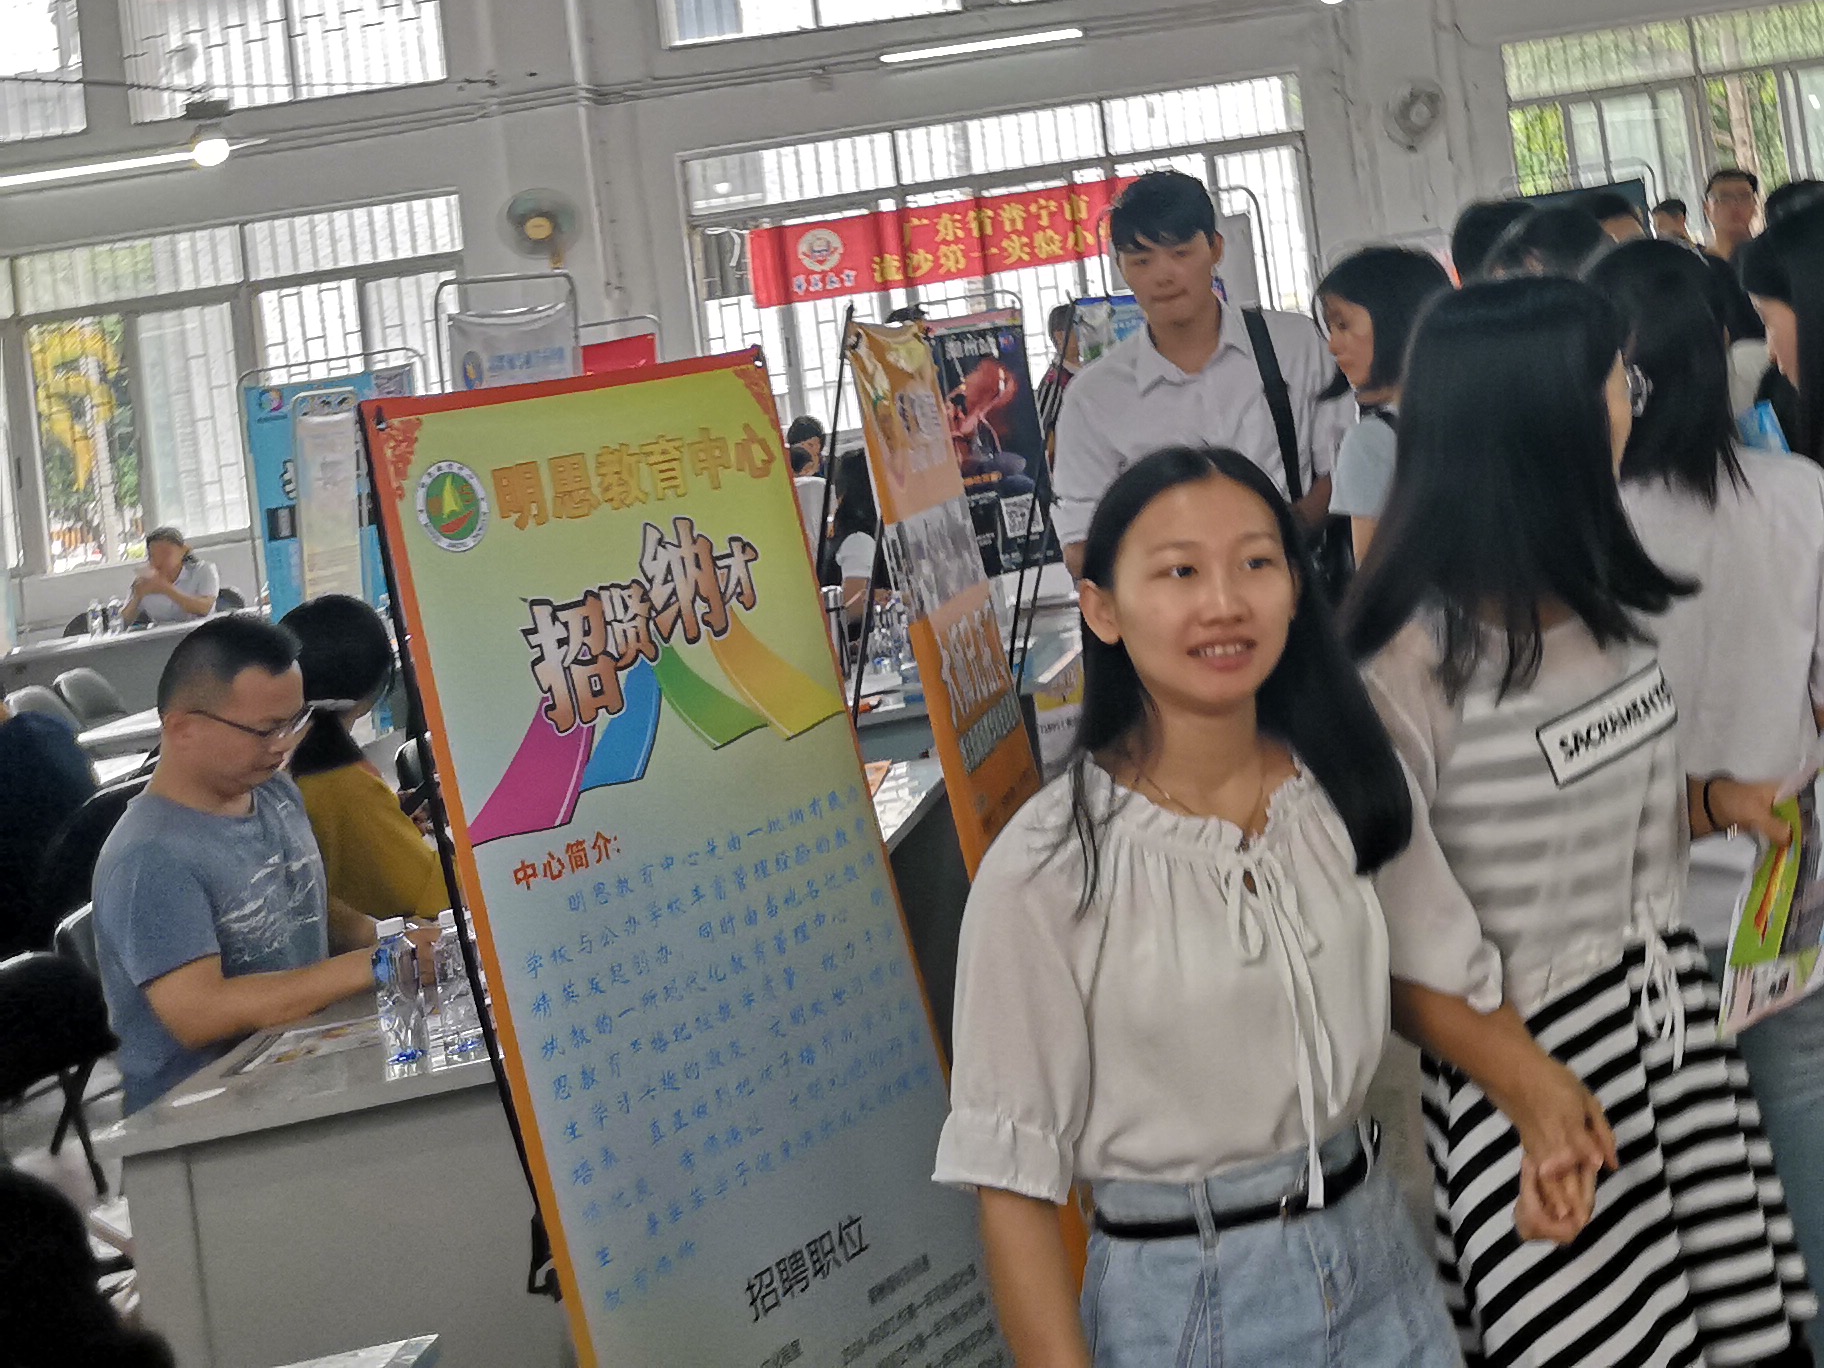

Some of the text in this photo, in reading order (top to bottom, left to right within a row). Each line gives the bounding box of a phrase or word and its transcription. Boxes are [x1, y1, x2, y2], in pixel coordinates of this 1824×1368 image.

[491, 423, 776, 530] 明思教育中心
[518, 517, 759, 734] 招贤纳才
[745, 1215, 870, 1323] 招聘职位
